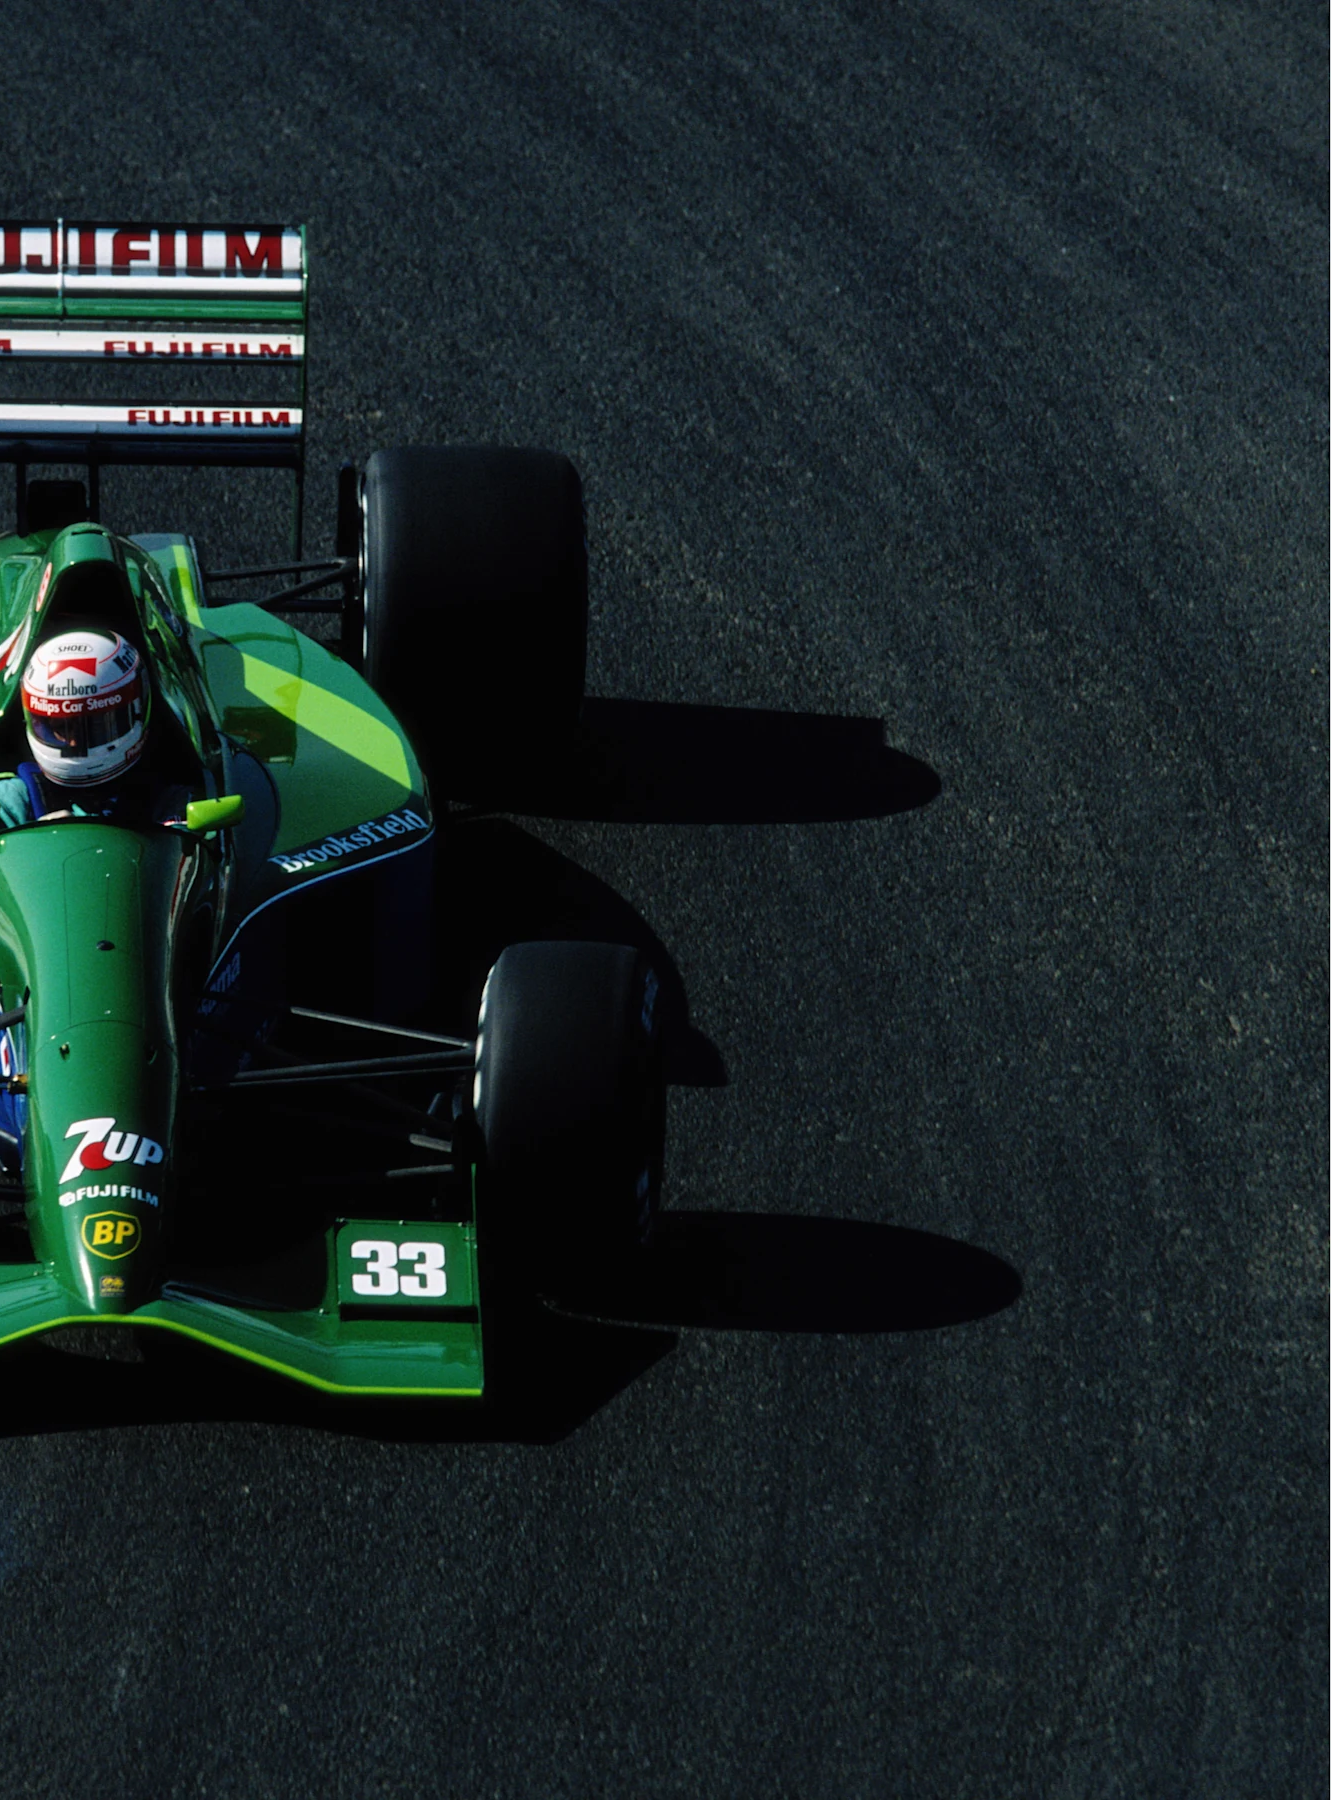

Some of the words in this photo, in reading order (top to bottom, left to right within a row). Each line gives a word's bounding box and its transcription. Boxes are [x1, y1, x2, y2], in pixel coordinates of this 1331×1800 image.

[104, 341, 293, 359] FUJIFILM
[128, 409, 292, 427] FUJIFILM
[57, 644, 88, 653] SHOEI
[47, 678, 98, 697] Marlboro
[30, 695, 60, 716] Philips
[61, 700, 83, 714] Car
[86, 693, 122, 711] Stereo
[269, 808, 429, 873] Brooksfield
[76, 1184, 159, 1208] FUJIFILM
[92, 1220, 135, 1246] BP
[351, 1240, 447, 1297] 33
